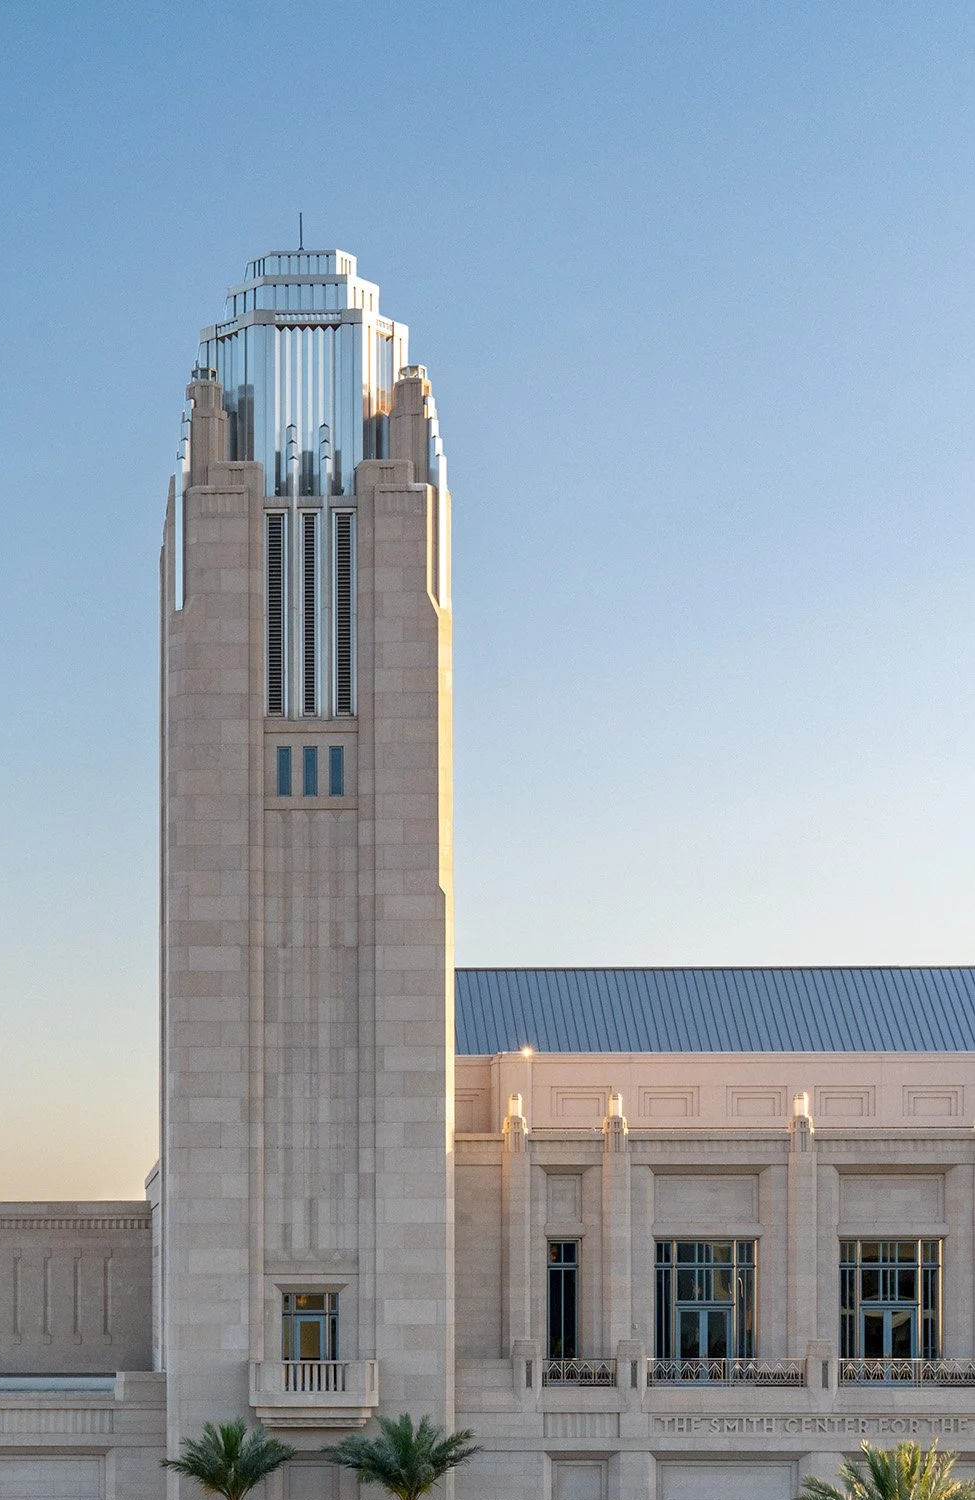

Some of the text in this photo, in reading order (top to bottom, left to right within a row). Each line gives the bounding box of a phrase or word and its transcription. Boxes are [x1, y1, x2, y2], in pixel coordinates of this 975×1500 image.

[659, 1418, 969, 1433] THE SMITH CENTER FOR THE
